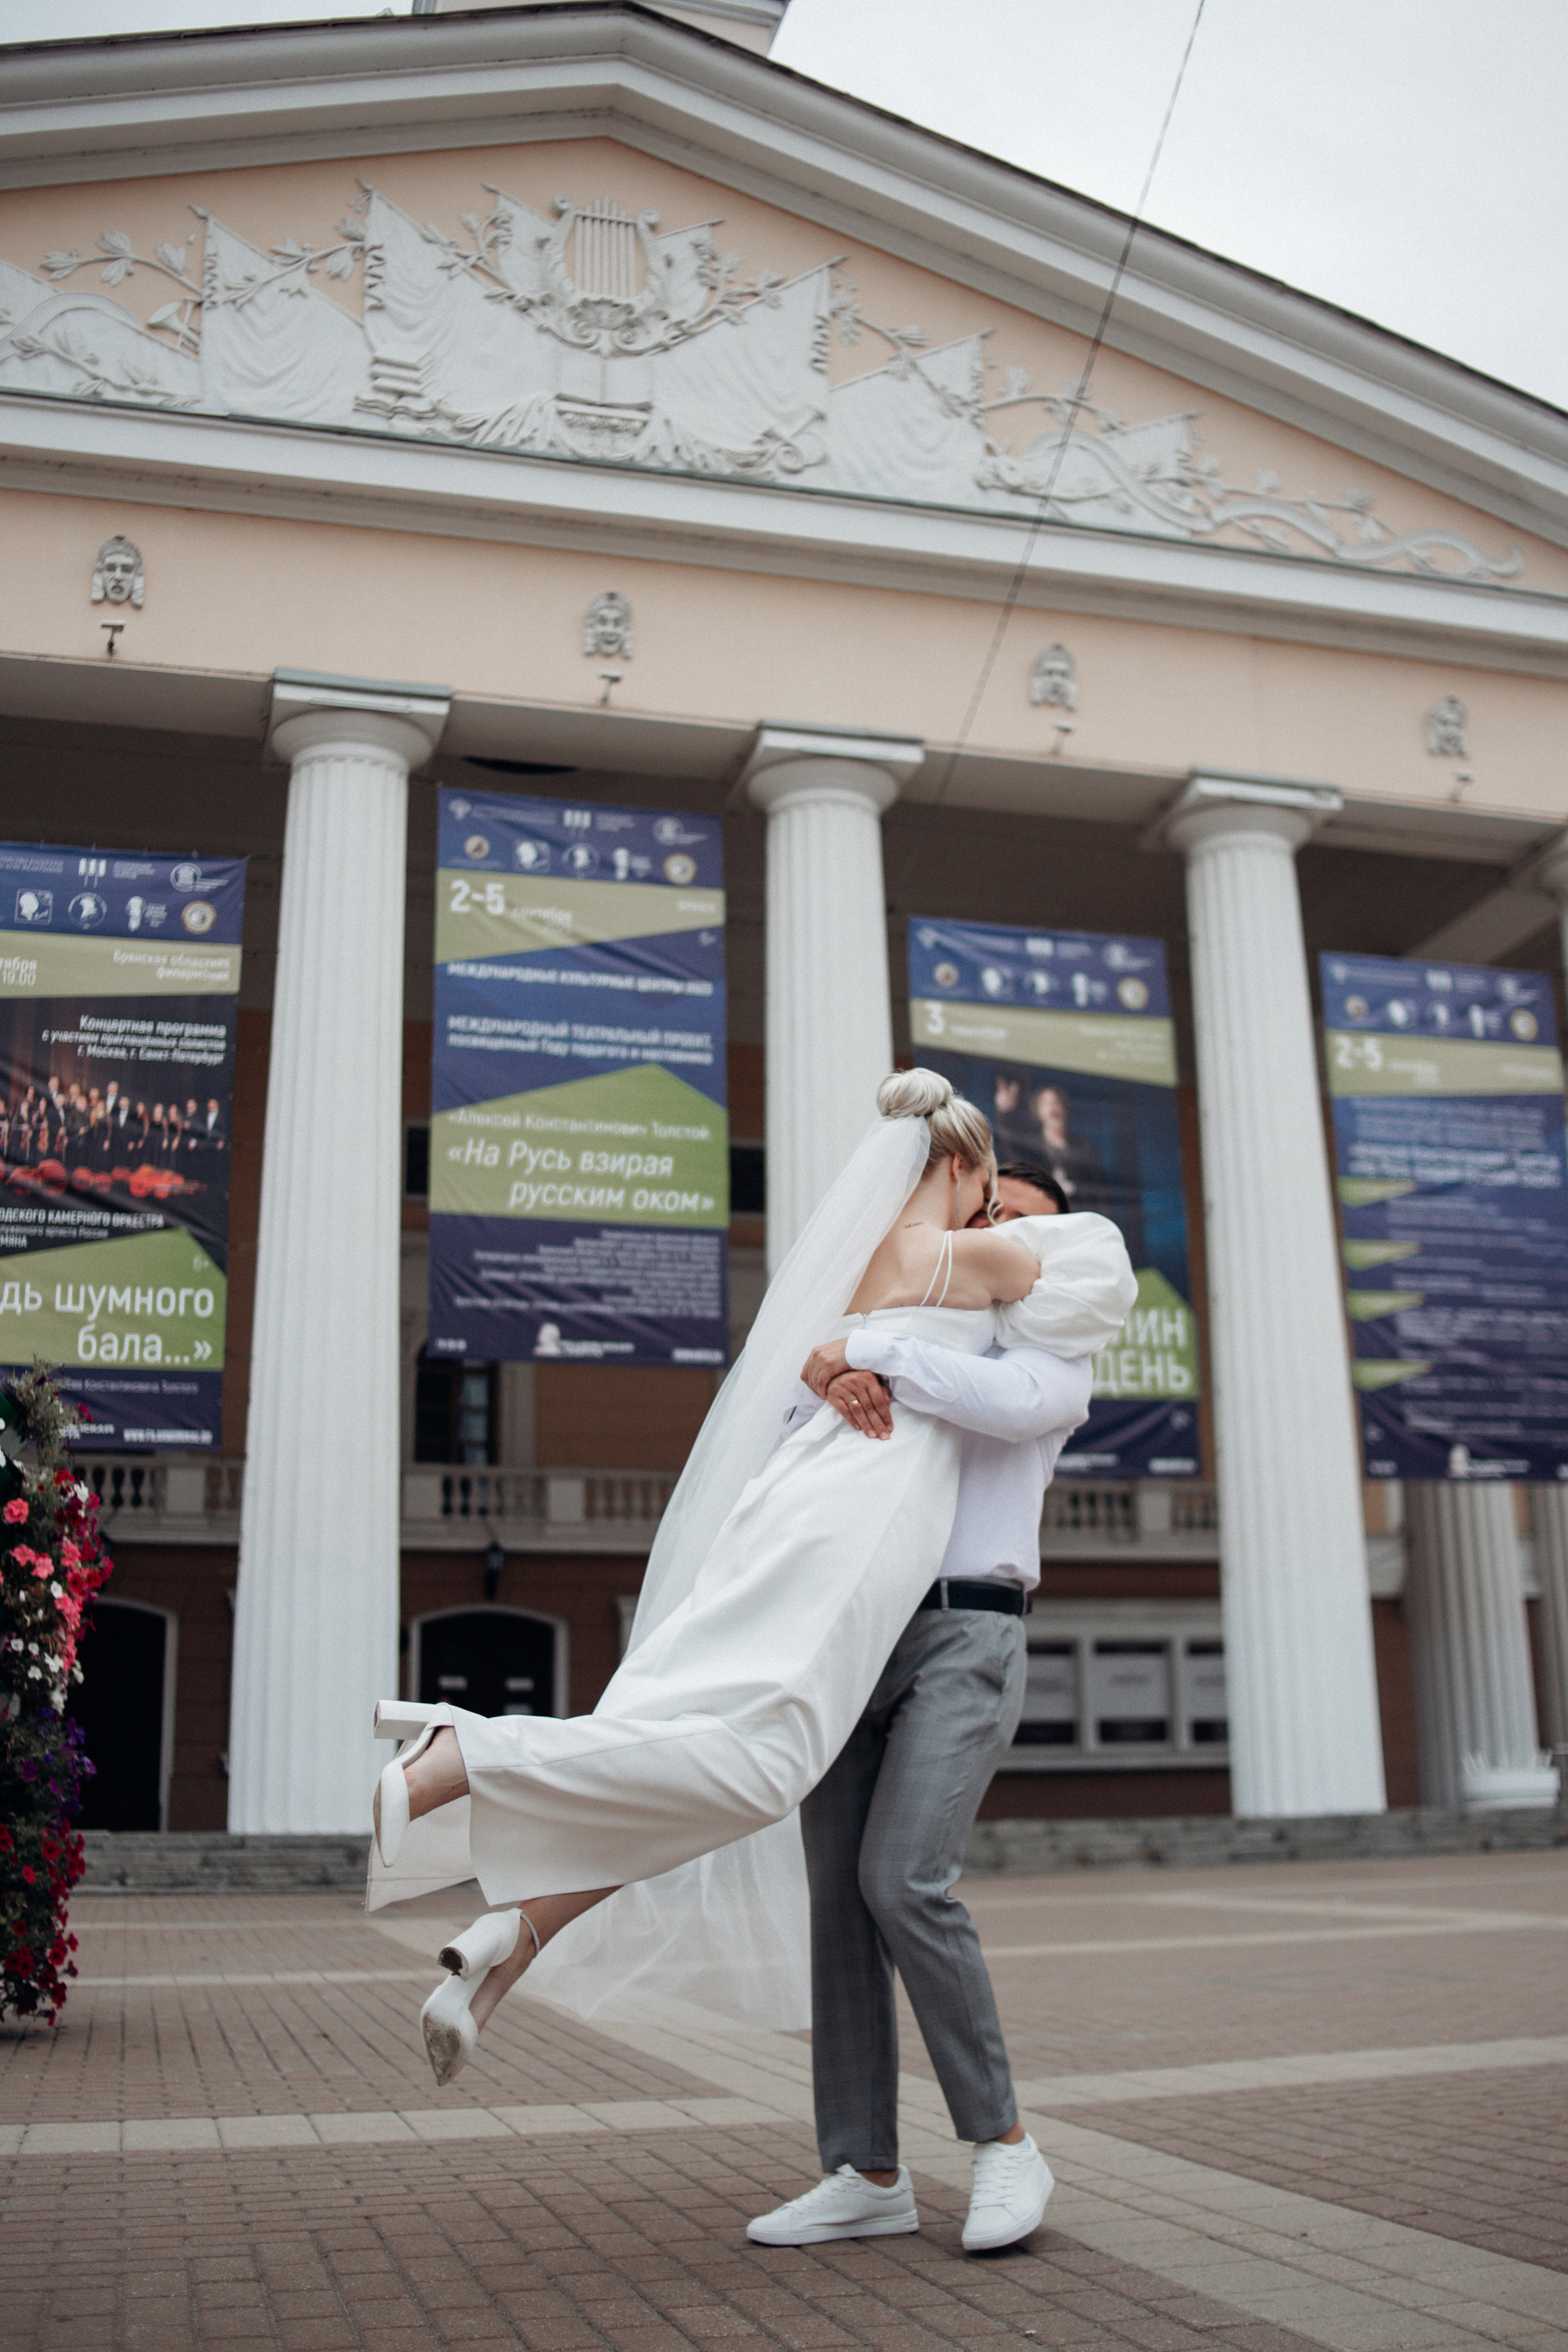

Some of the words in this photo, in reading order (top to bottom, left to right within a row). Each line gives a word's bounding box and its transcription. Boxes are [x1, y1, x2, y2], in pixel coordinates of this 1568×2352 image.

[451, 880, 505, 914] 2-5
[80, 1014, 154, 1034] Концертная
[156, 1021, 227, 1039] программа
[925, 1001, 946, 1035] 3
[50, 1030, 99, 1044] участием
[448, 1139, 499, 1167] «На
[509, 1140, 571, 1175] Русь
[579, 1151, 673, 1180] взирая
[509, 1182, 624, 1210] русским
[633, 1189, 714, 1212] оком»
[48, 1209, 111, 1226] КАМЕРНОГО
[112, 1212, 165, 1229] ОРКЕСТРА
[55, 1283, 214, 1321] шумного
[78, 1324, 213, 1363] бала...»
[1092, 1350, 1192, 1396] ДЕНЬ
